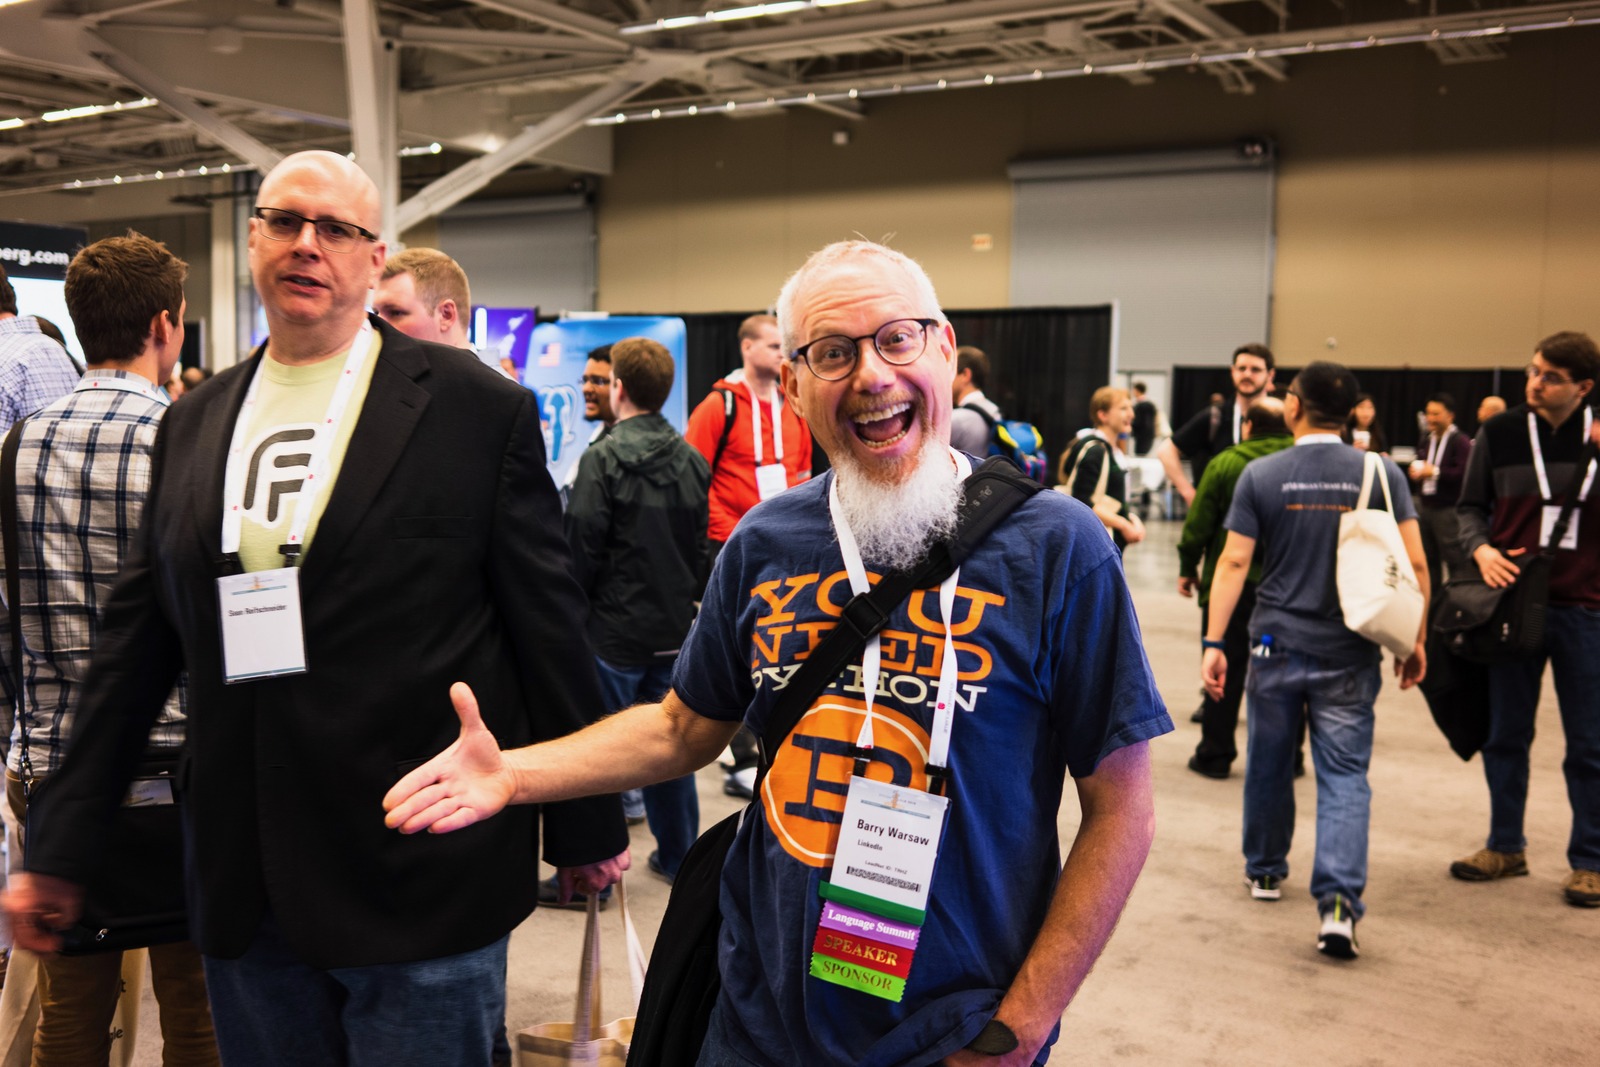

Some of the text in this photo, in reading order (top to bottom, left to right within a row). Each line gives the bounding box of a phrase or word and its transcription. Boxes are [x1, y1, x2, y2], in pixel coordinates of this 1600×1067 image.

[0, 247, 69, 267] erg.com
[751, 662, 988, 712] YHON
[857, 818, 930, 846] Barry Warsaw
[857, 839, 883, 851] LinkedIn
[827, 909, 916, 941] Language Summit
[823, 934, 898, 967] SPEAKER
[822, 960, 893, 991] SPONSOR
